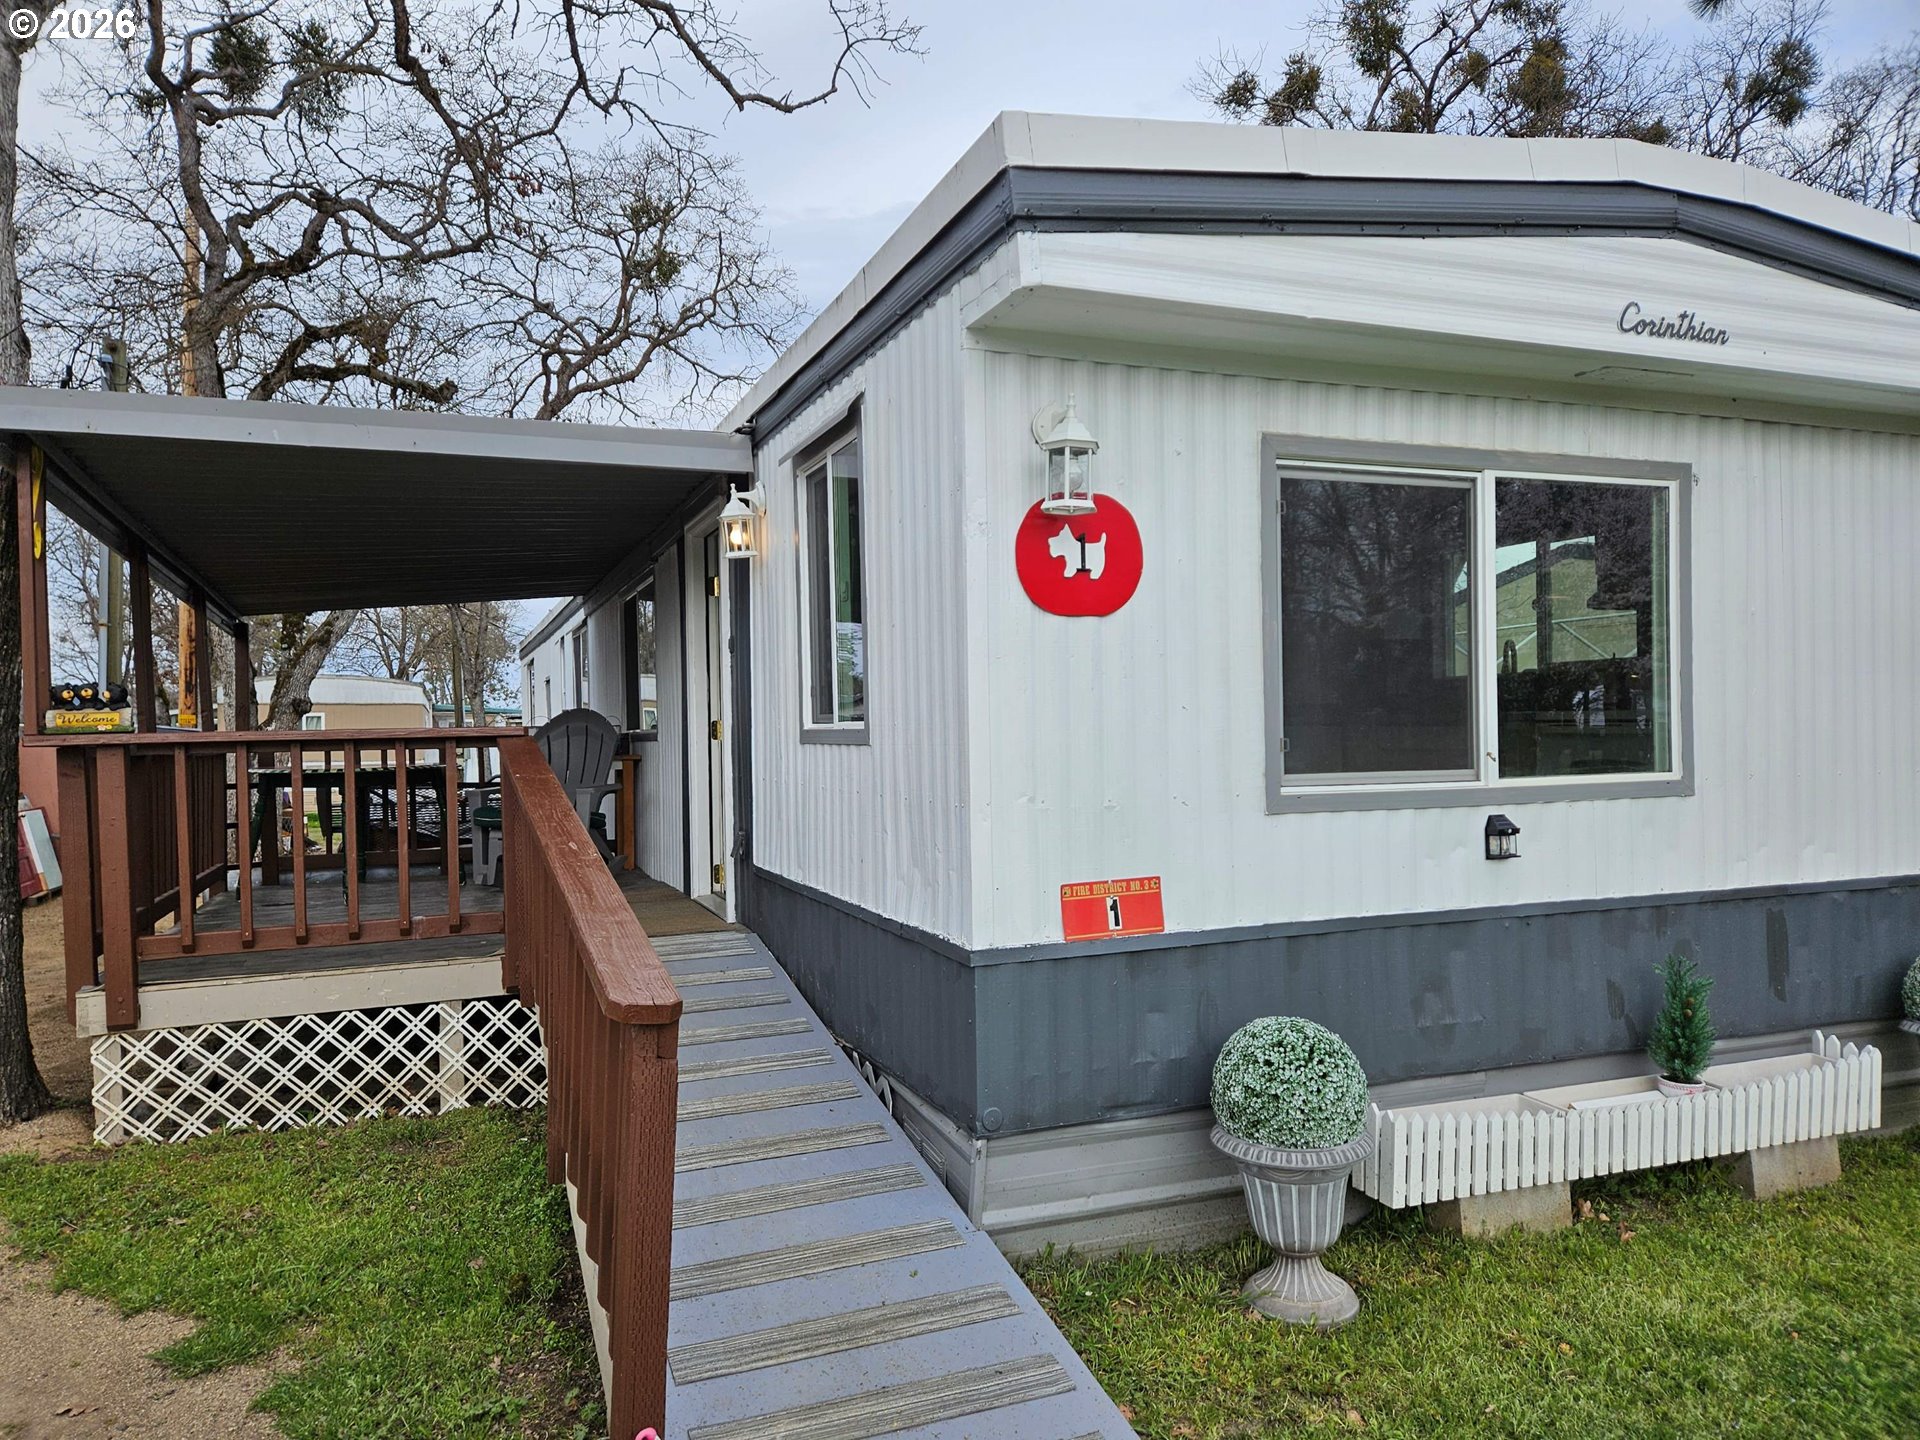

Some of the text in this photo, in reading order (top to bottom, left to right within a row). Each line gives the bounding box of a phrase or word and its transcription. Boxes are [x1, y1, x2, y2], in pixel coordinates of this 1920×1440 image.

[1617, 301, 1730, 345] Corinthian
[58, 713, 117, 724] Welcome
[1072, 879, 1149, 897] FIRE DISTRICT NO. 3
[1110, 899, 1120, 927] 1
